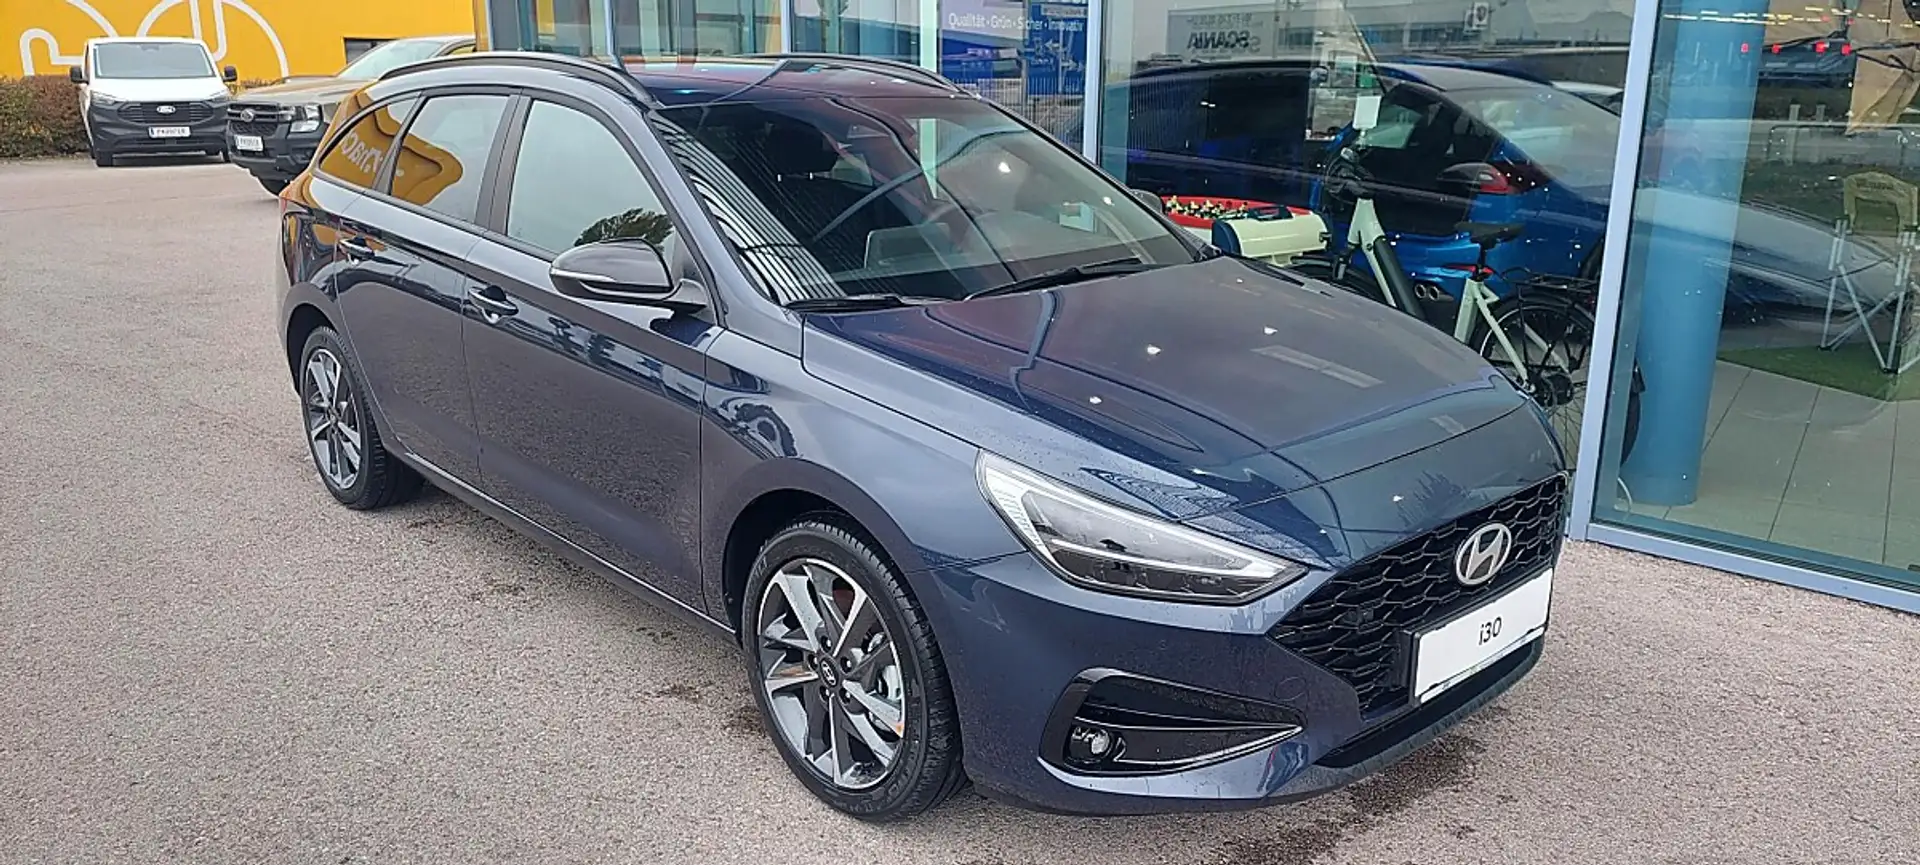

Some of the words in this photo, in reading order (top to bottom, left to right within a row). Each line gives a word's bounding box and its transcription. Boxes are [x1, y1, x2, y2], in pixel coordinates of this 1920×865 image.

[949, 13, 985, 29] Qualität
[991, 15, 1012, 29] Grün
[1478, 616, 1502, 645] i30
